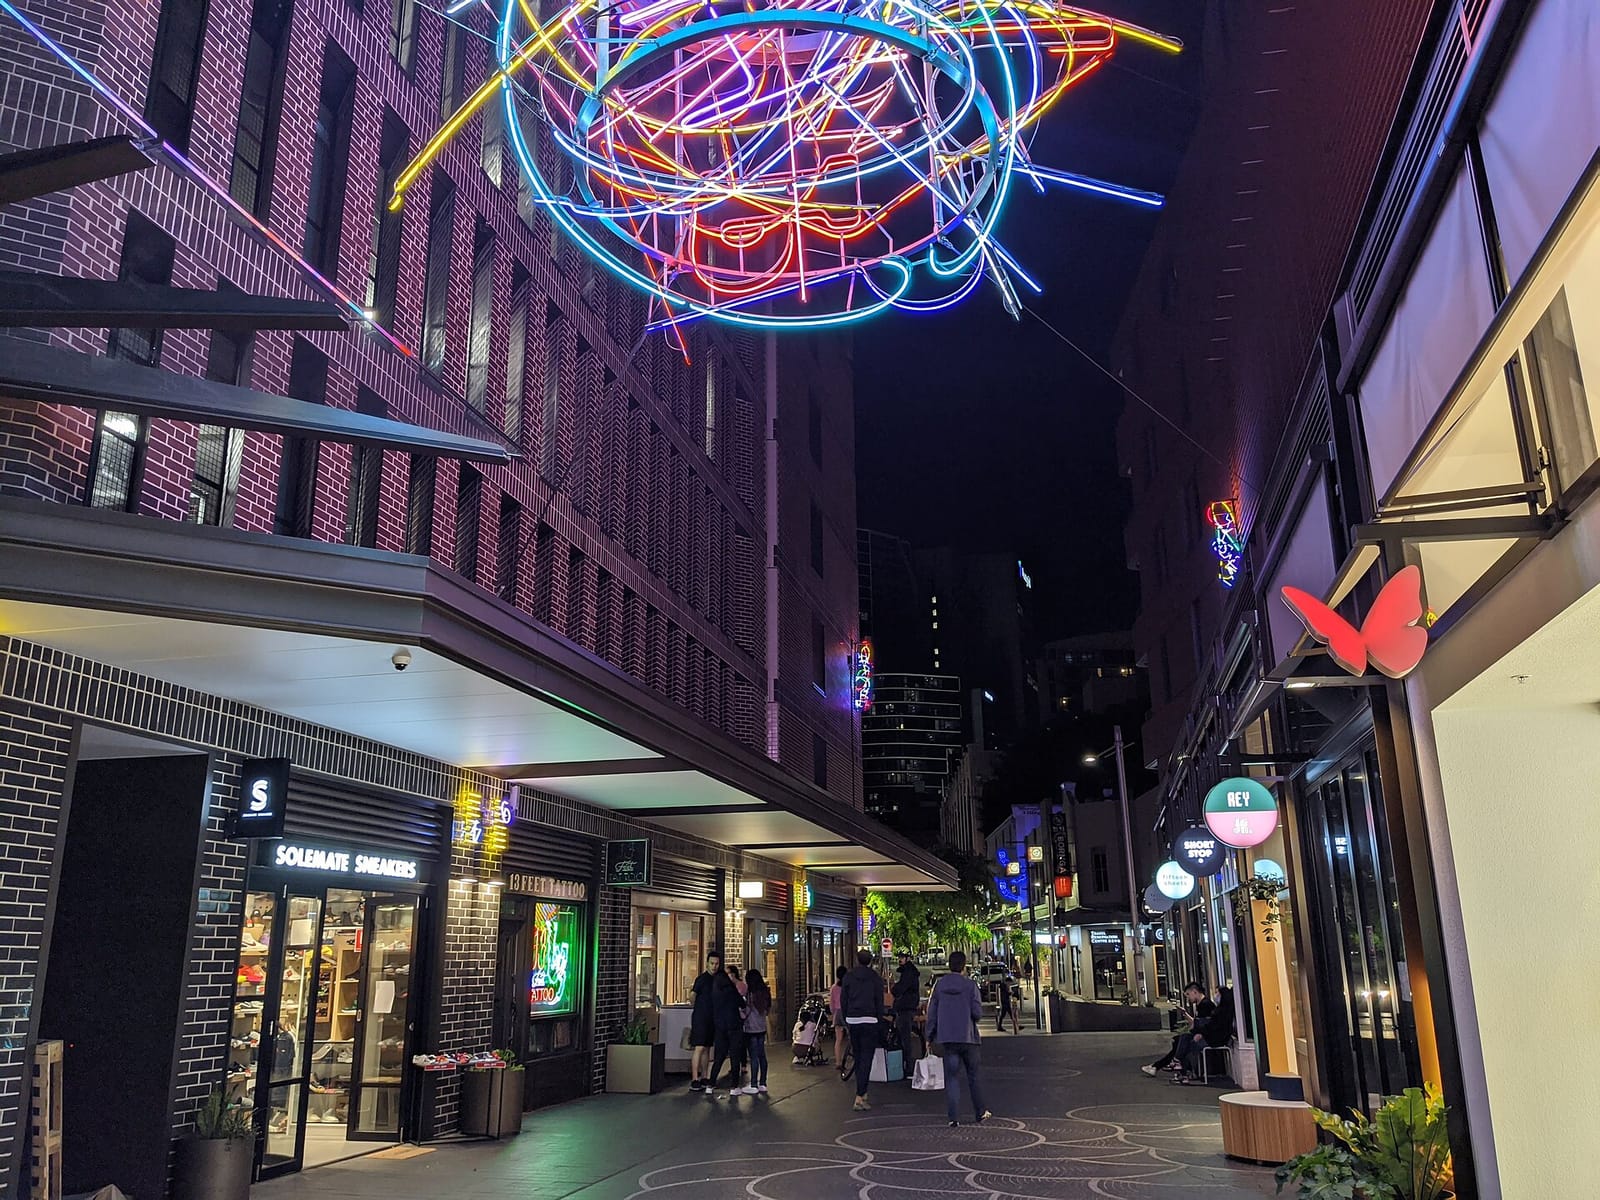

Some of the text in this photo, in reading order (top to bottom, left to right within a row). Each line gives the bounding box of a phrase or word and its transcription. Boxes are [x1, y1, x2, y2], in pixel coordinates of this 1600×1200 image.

[250, 779, 268, 811] S
[1227, 791, 1250, 808] REY
[1183, 840, 1215, 850] SHORT
[1188, 849, 1213, 858] STOP
[275, 844, 417, 879] SOLEMATE SNEAKERS
[509, 873, 586, 899] 13 FEET TATTOO
[530, 987, 555, 1001] ATTOO
